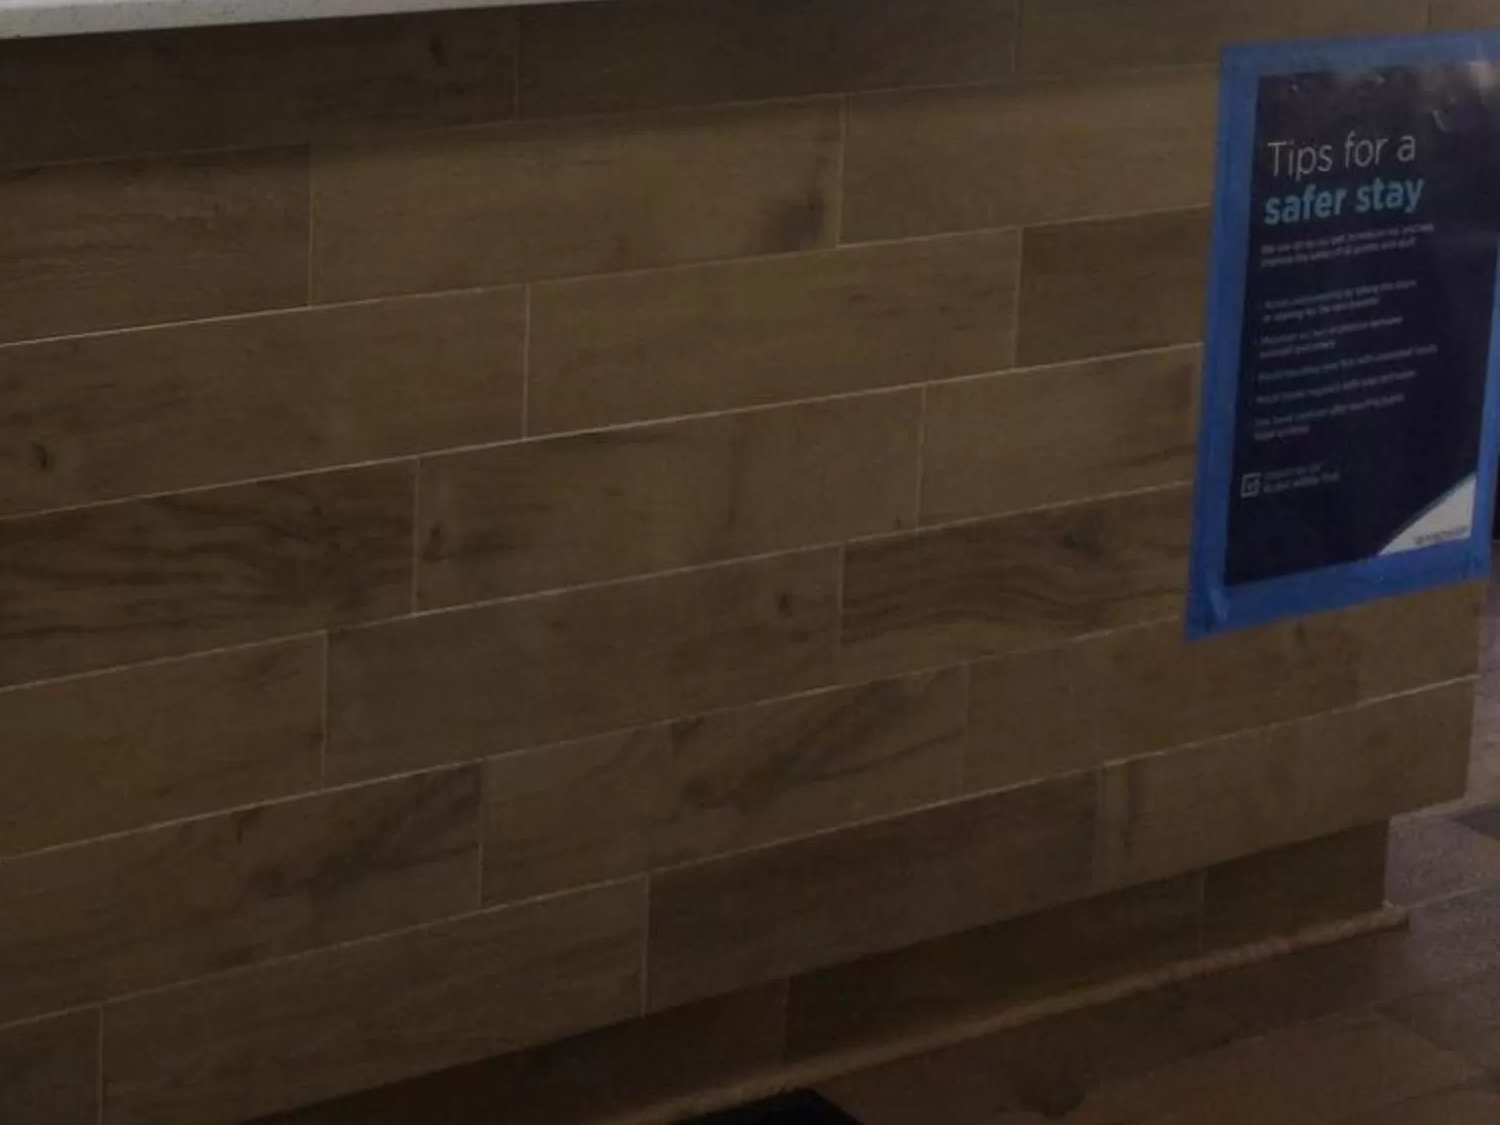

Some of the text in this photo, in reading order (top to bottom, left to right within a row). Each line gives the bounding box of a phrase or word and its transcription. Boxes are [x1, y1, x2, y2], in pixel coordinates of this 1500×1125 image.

[1266, 130, 1416, 181] Tips for a
[1263, 175, 1425, 226] safer stay
